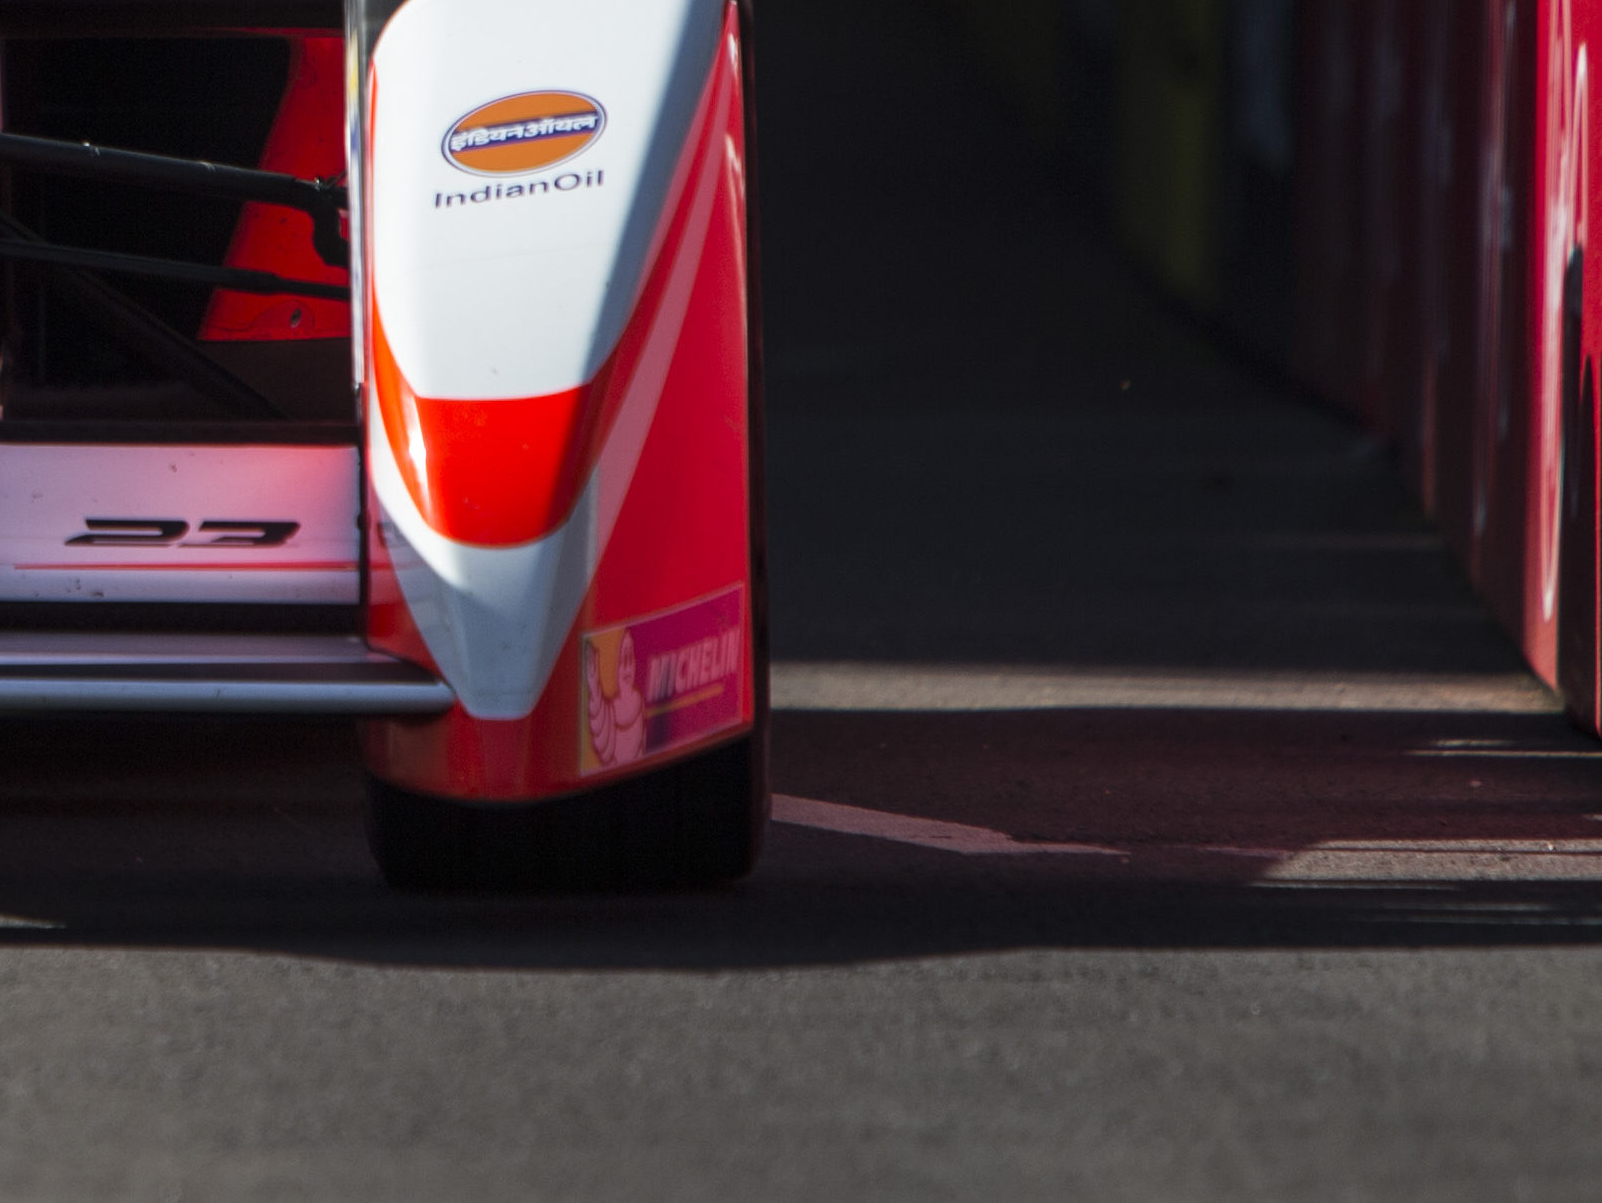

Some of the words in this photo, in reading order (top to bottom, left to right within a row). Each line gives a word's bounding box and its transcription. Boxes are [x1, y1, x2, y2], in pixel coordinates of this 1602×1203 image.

[434, 170, 604, 208] IndianOil
[63, 517, 301, 548] 23
[647, 623, 742, 702] MICHELIN
